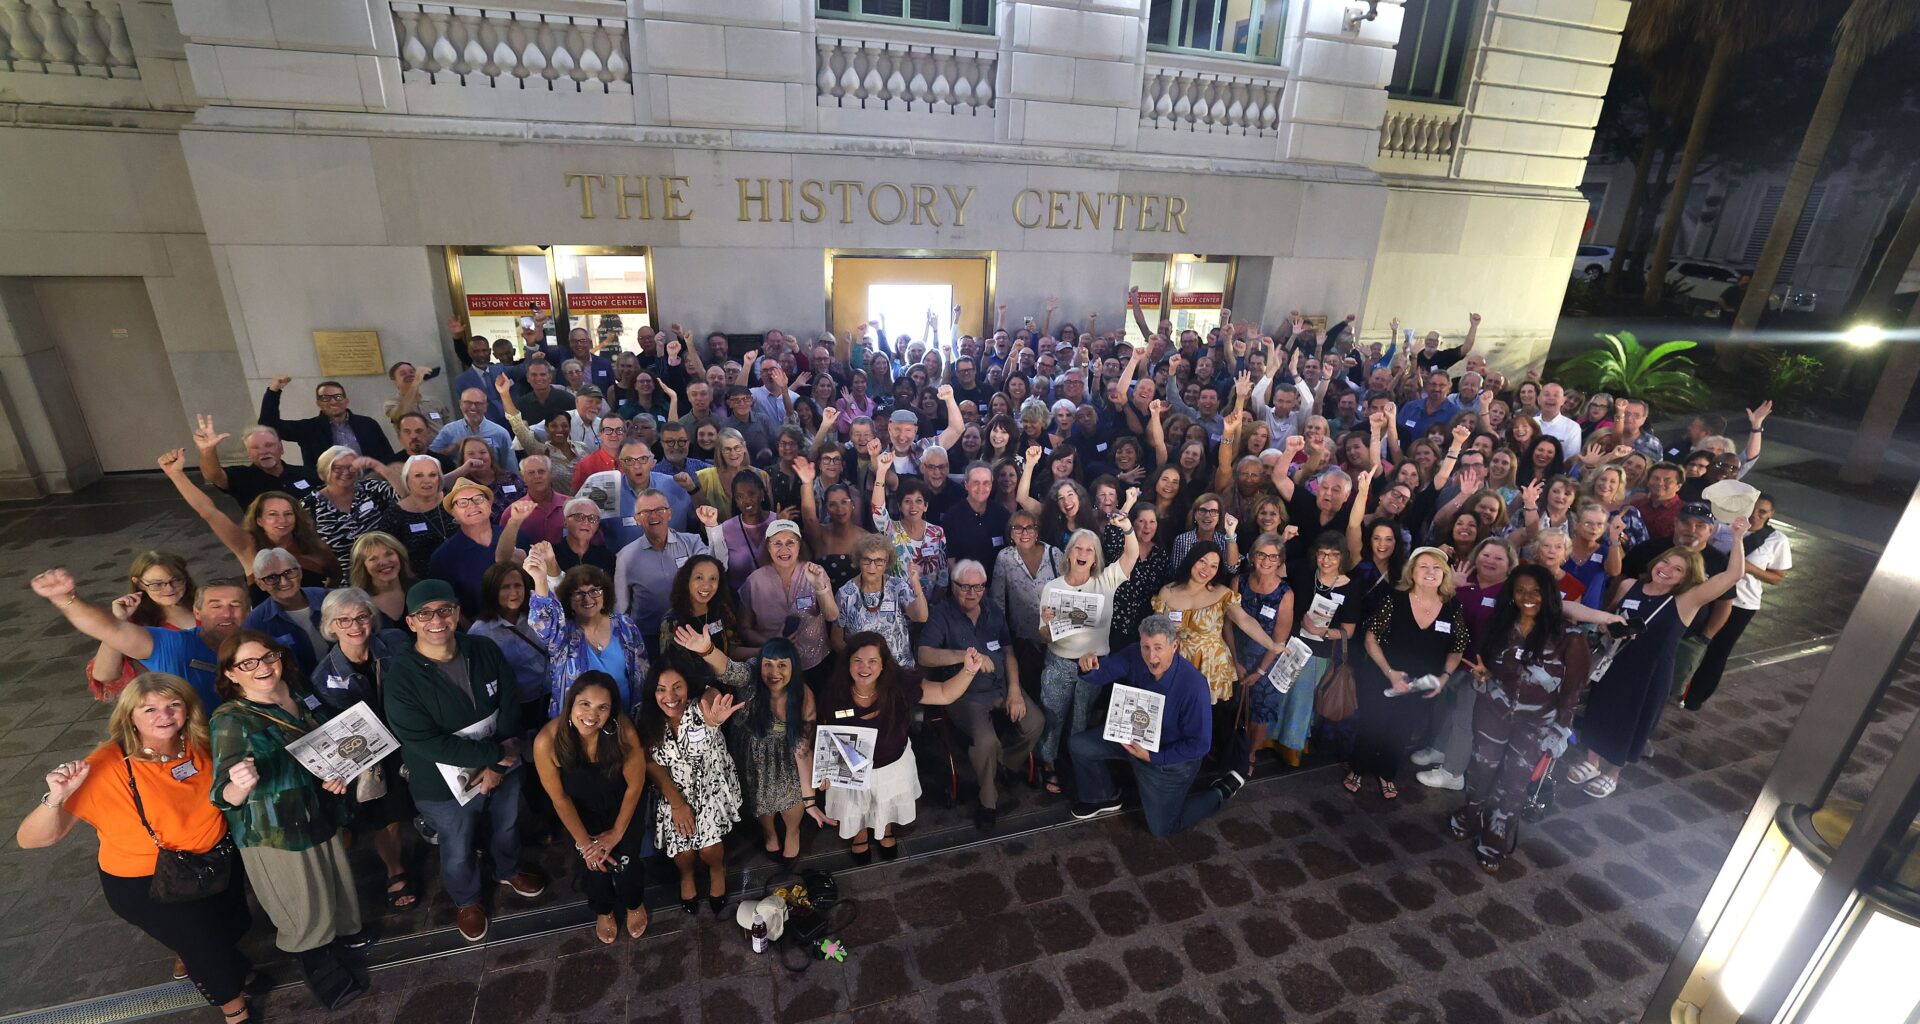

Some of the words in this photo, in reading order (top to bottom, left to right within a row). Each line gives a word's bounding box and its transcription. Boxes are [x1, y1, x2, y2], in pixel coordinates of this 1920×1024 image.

[564, 172, 694, 221] THE
[735, 177, 977, 227] HISTORY
[1012, 187, 1189, 234] CENTER
[572, 299, 608, 307] HISTORY
[1133, 713, 1148, 724] 150
[340, 738, 363, 755] 150
